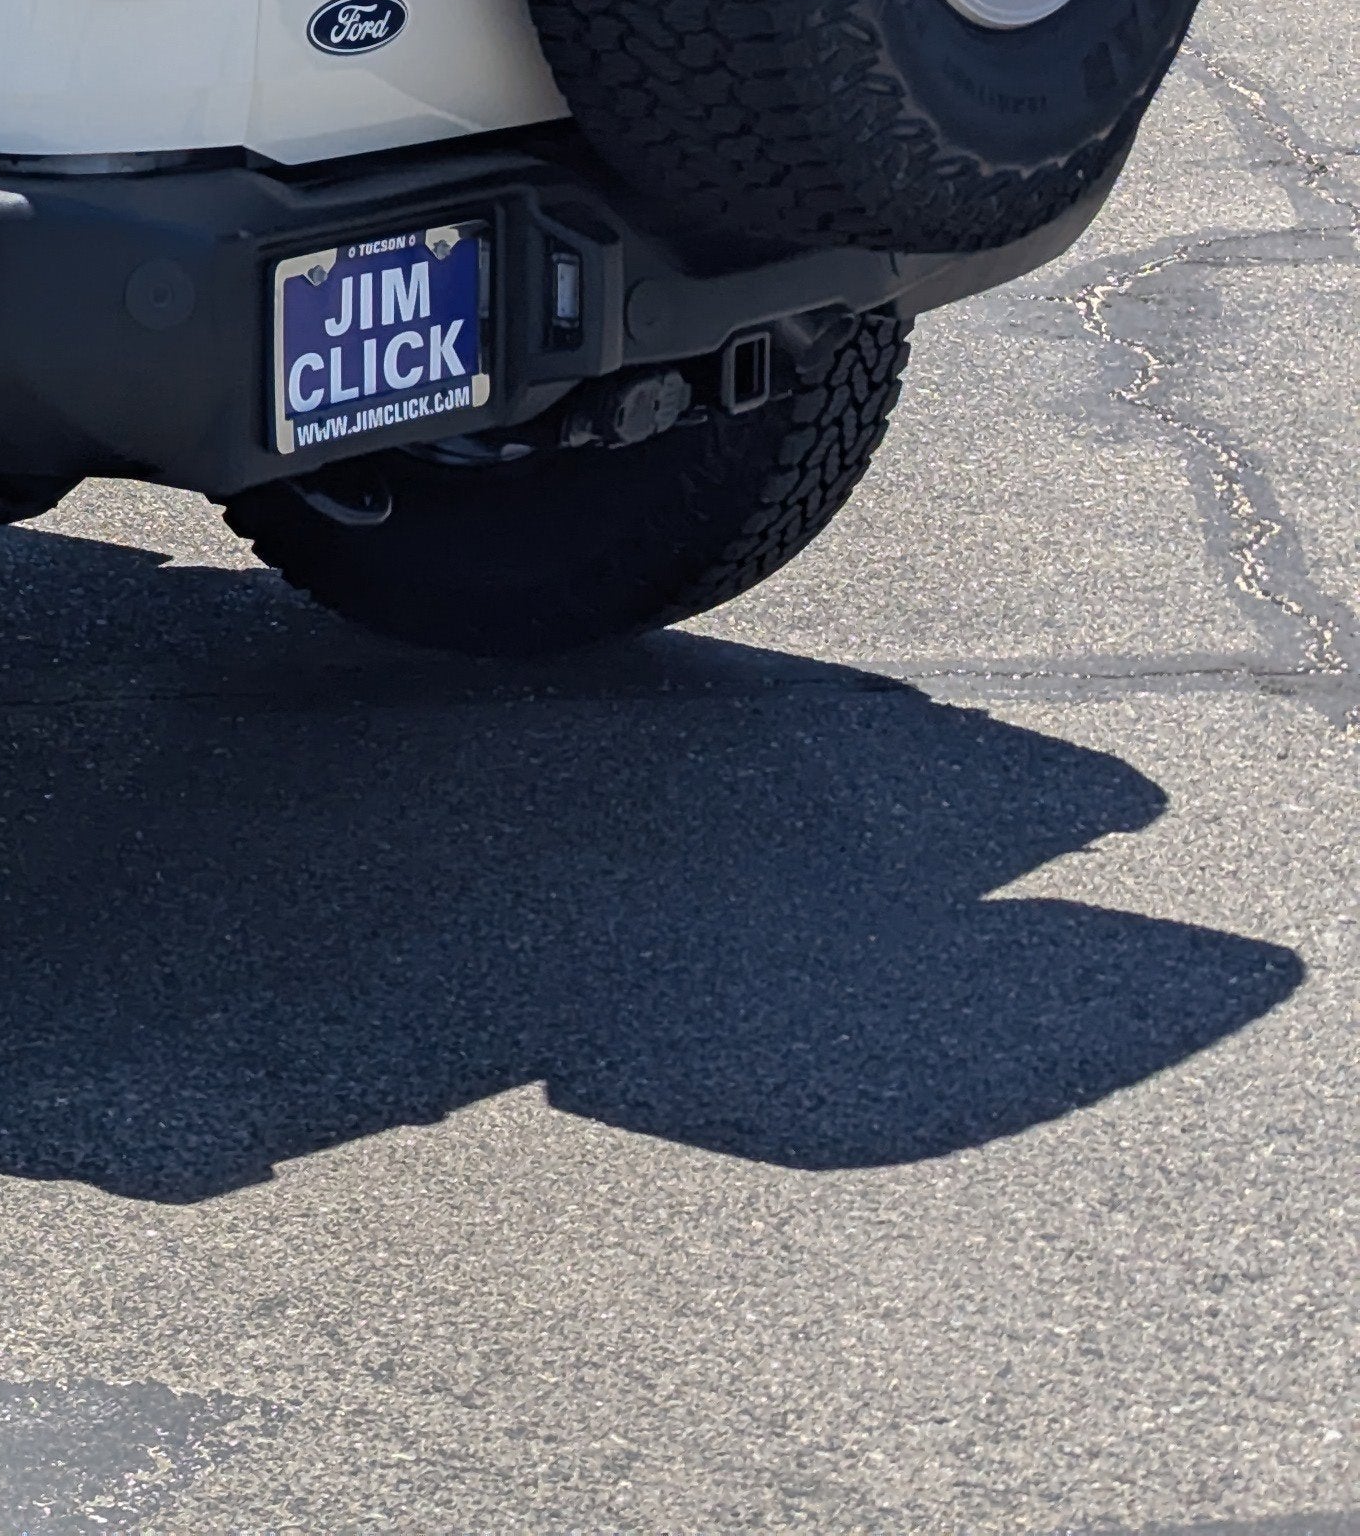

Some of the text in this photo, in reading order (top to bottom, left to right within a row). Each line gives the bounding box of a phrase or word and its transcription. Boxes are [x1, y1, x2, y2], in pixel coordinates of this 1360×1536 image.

[330, 4, 392, 44] Ford
[359, 235, 406, 255] TUCSON
[324, 261, 431, 337] JIM
[288, 319, 467, 413] CLICK
[297, 385, 470, 447] WWW.JIMCLICK.COM
